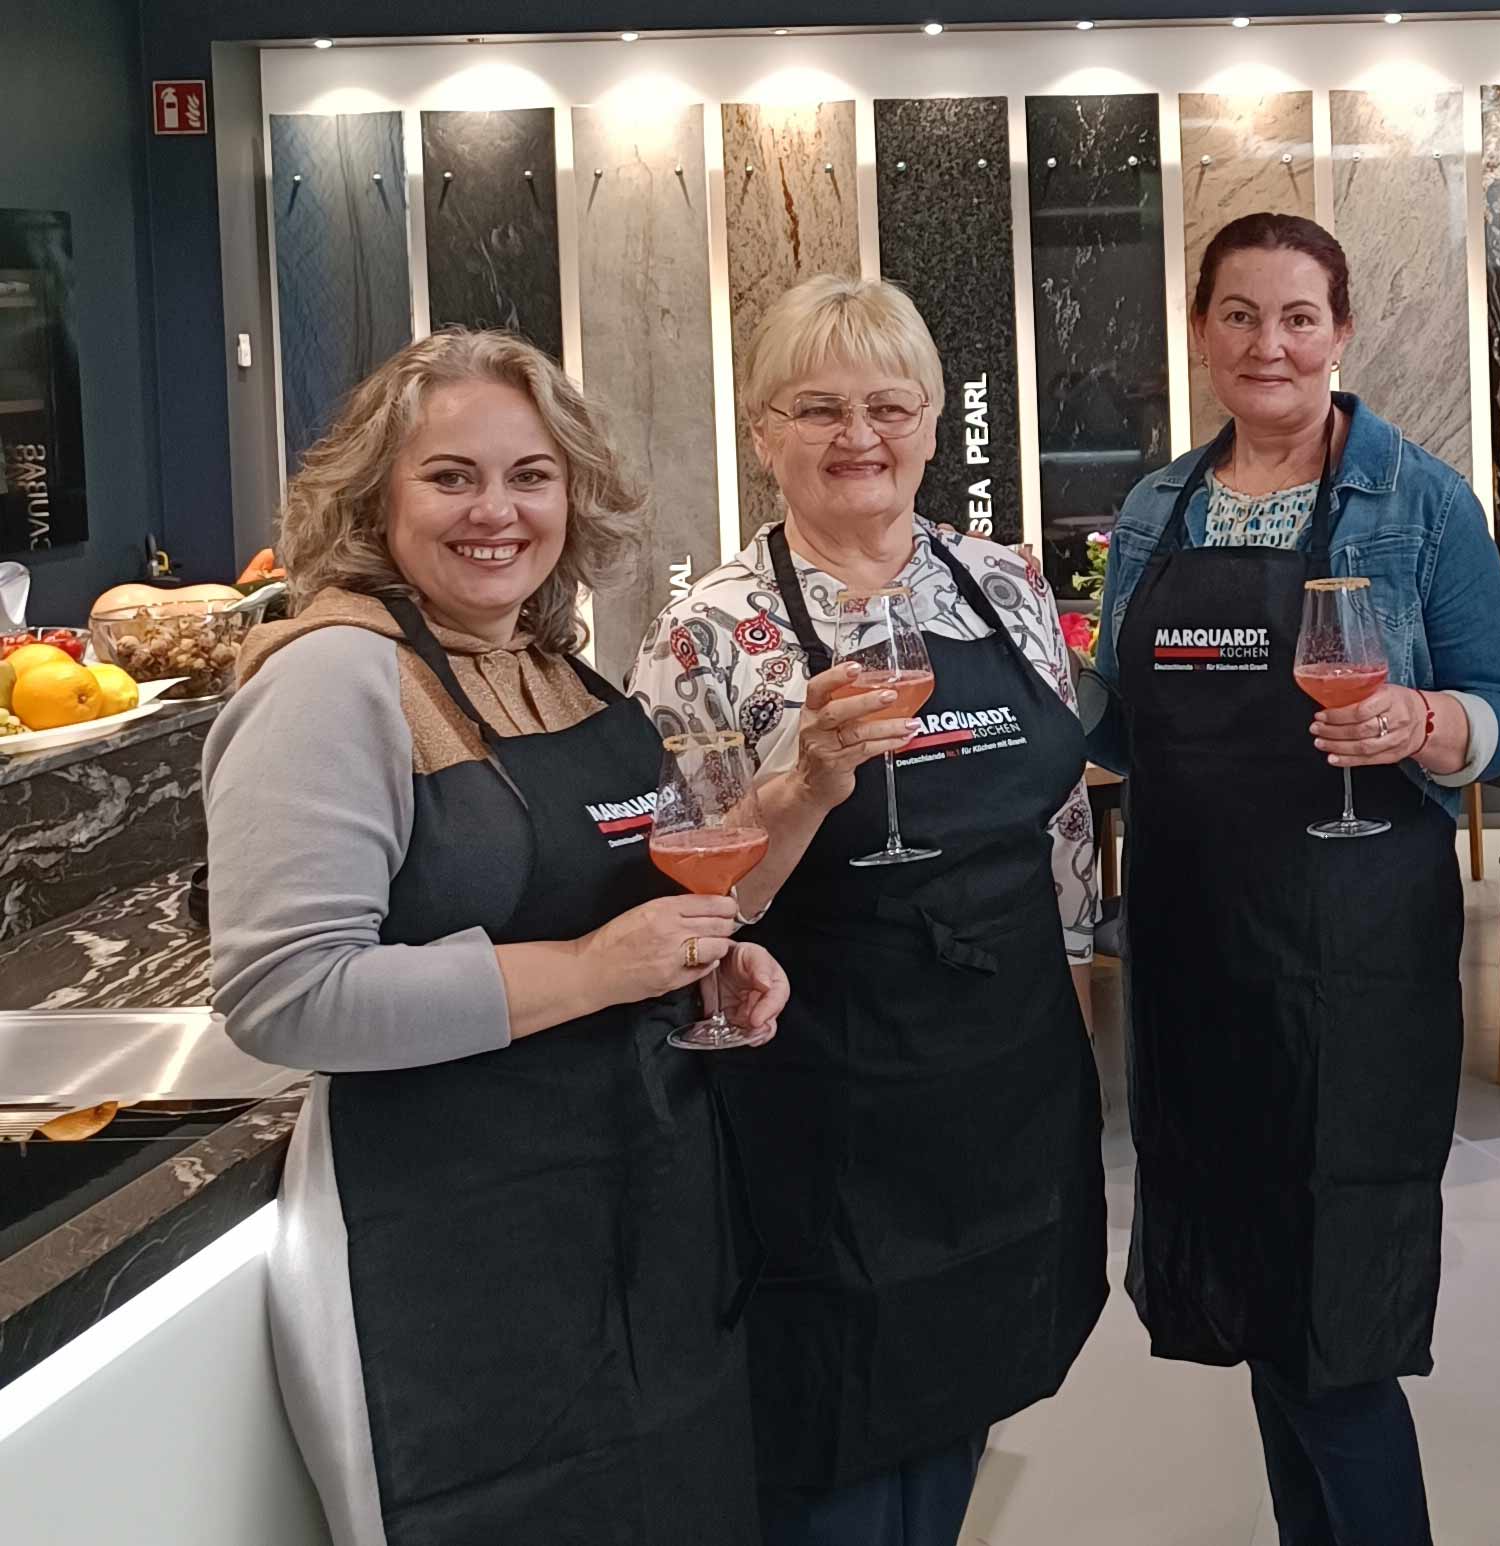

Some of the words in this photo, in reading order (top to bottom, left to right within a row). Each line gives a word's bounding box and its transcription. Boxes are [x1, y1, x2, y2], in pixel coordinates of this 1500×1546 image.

[963, 372, 990, 465] PEARL
[968, 478, 993, 537] SEA
[914, 706, 1017, 737] ARQUARDT.
